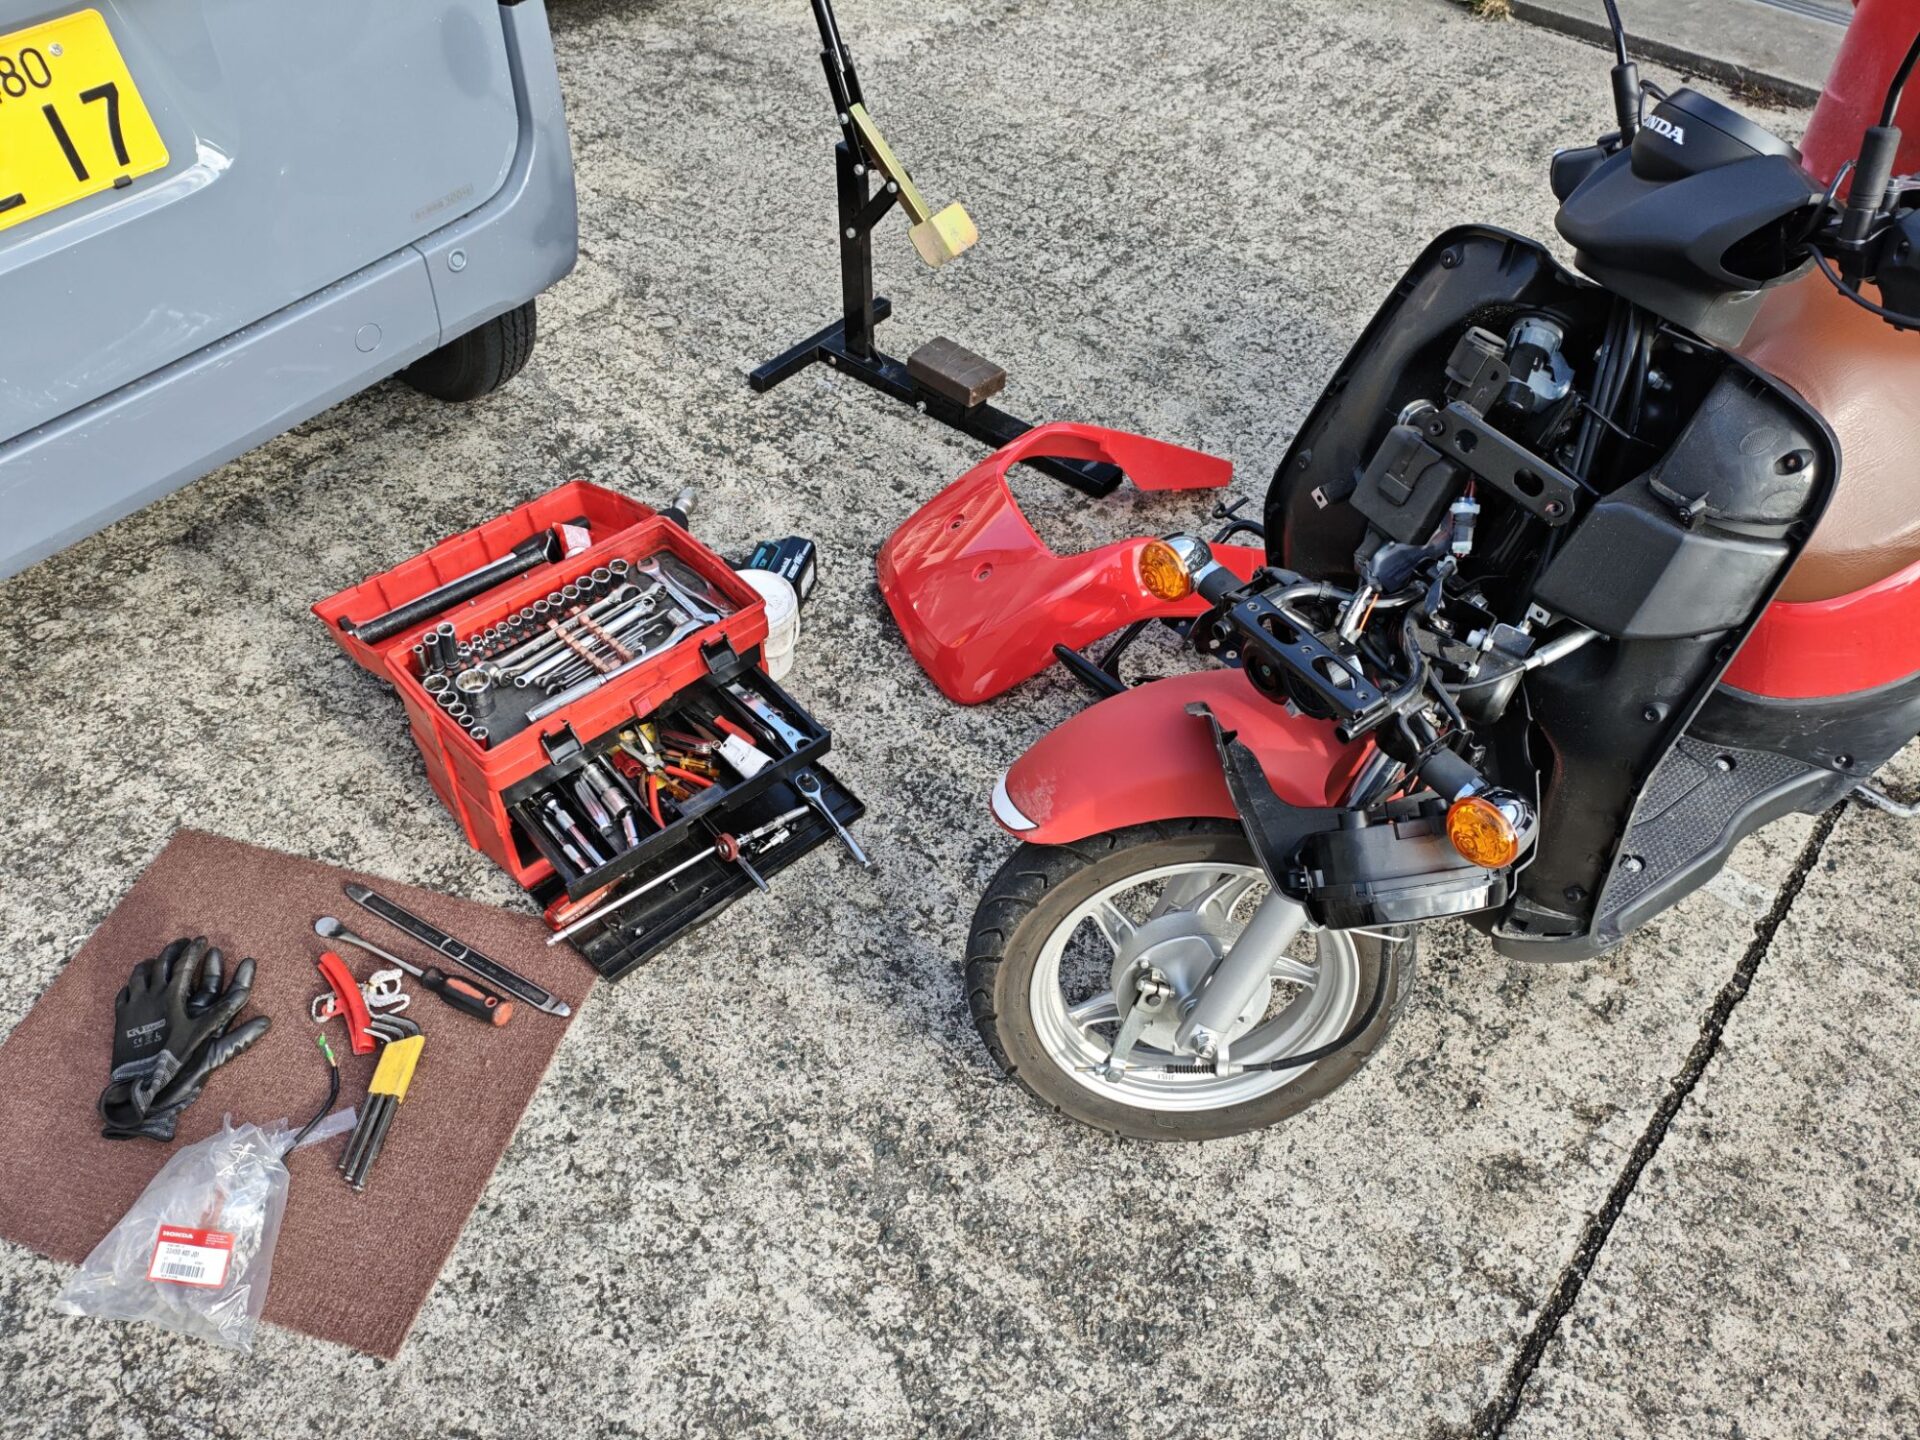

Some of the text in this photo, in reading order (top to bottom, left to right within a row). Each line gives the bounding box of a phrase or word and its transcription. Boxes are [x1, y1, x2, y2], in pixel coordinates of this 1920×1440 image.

[0, 48, 52, 103] 80
[1643, 114, 1684, 145] NDA
[162, 1230, 194, 1240] HONDA
